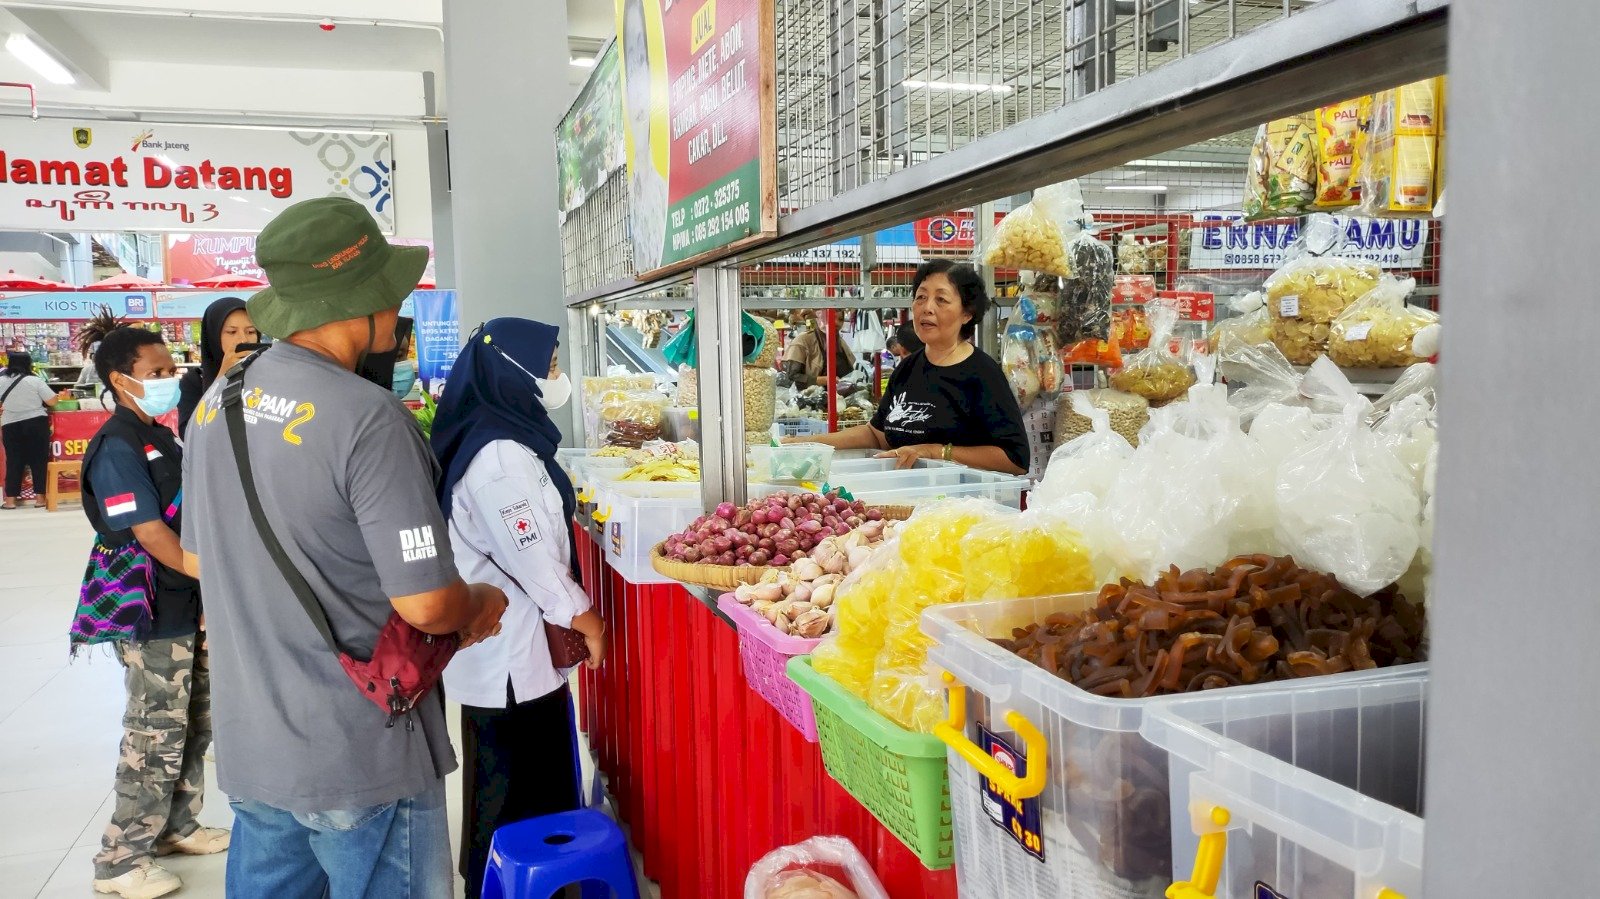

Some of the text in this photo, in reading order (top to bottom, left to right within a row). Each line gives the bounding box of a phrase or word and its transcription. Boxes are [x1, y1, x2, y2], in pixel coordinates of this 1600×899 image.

[142, 141, 190, 151] Bank Jateng
[142, 156, 293, 199] Datang
[672, 207, 686, 229] TELP
[693, 195, 710, 219] 0272
[714, 178, 740, 210] 325375
[694, 221, 707, 242] 085
[707, 215, 720, 238] 292
[721, 208, 734, 231] 154
[735, 201, 750, 226] 005
[812, 249, 831, 258] 137
[836, 249, 855, 258] 192
[1234, 254, 1260, 264] 0858
[1382, 254, 1399, 264] 418
[45, 301, 78, 311] KIOS
[128, 298, 144, 307] BRI
[399, 525, 435, 550] DLH
[519, 532, 538, 546] PMI
[1024, 829, 1041, 853] 30
